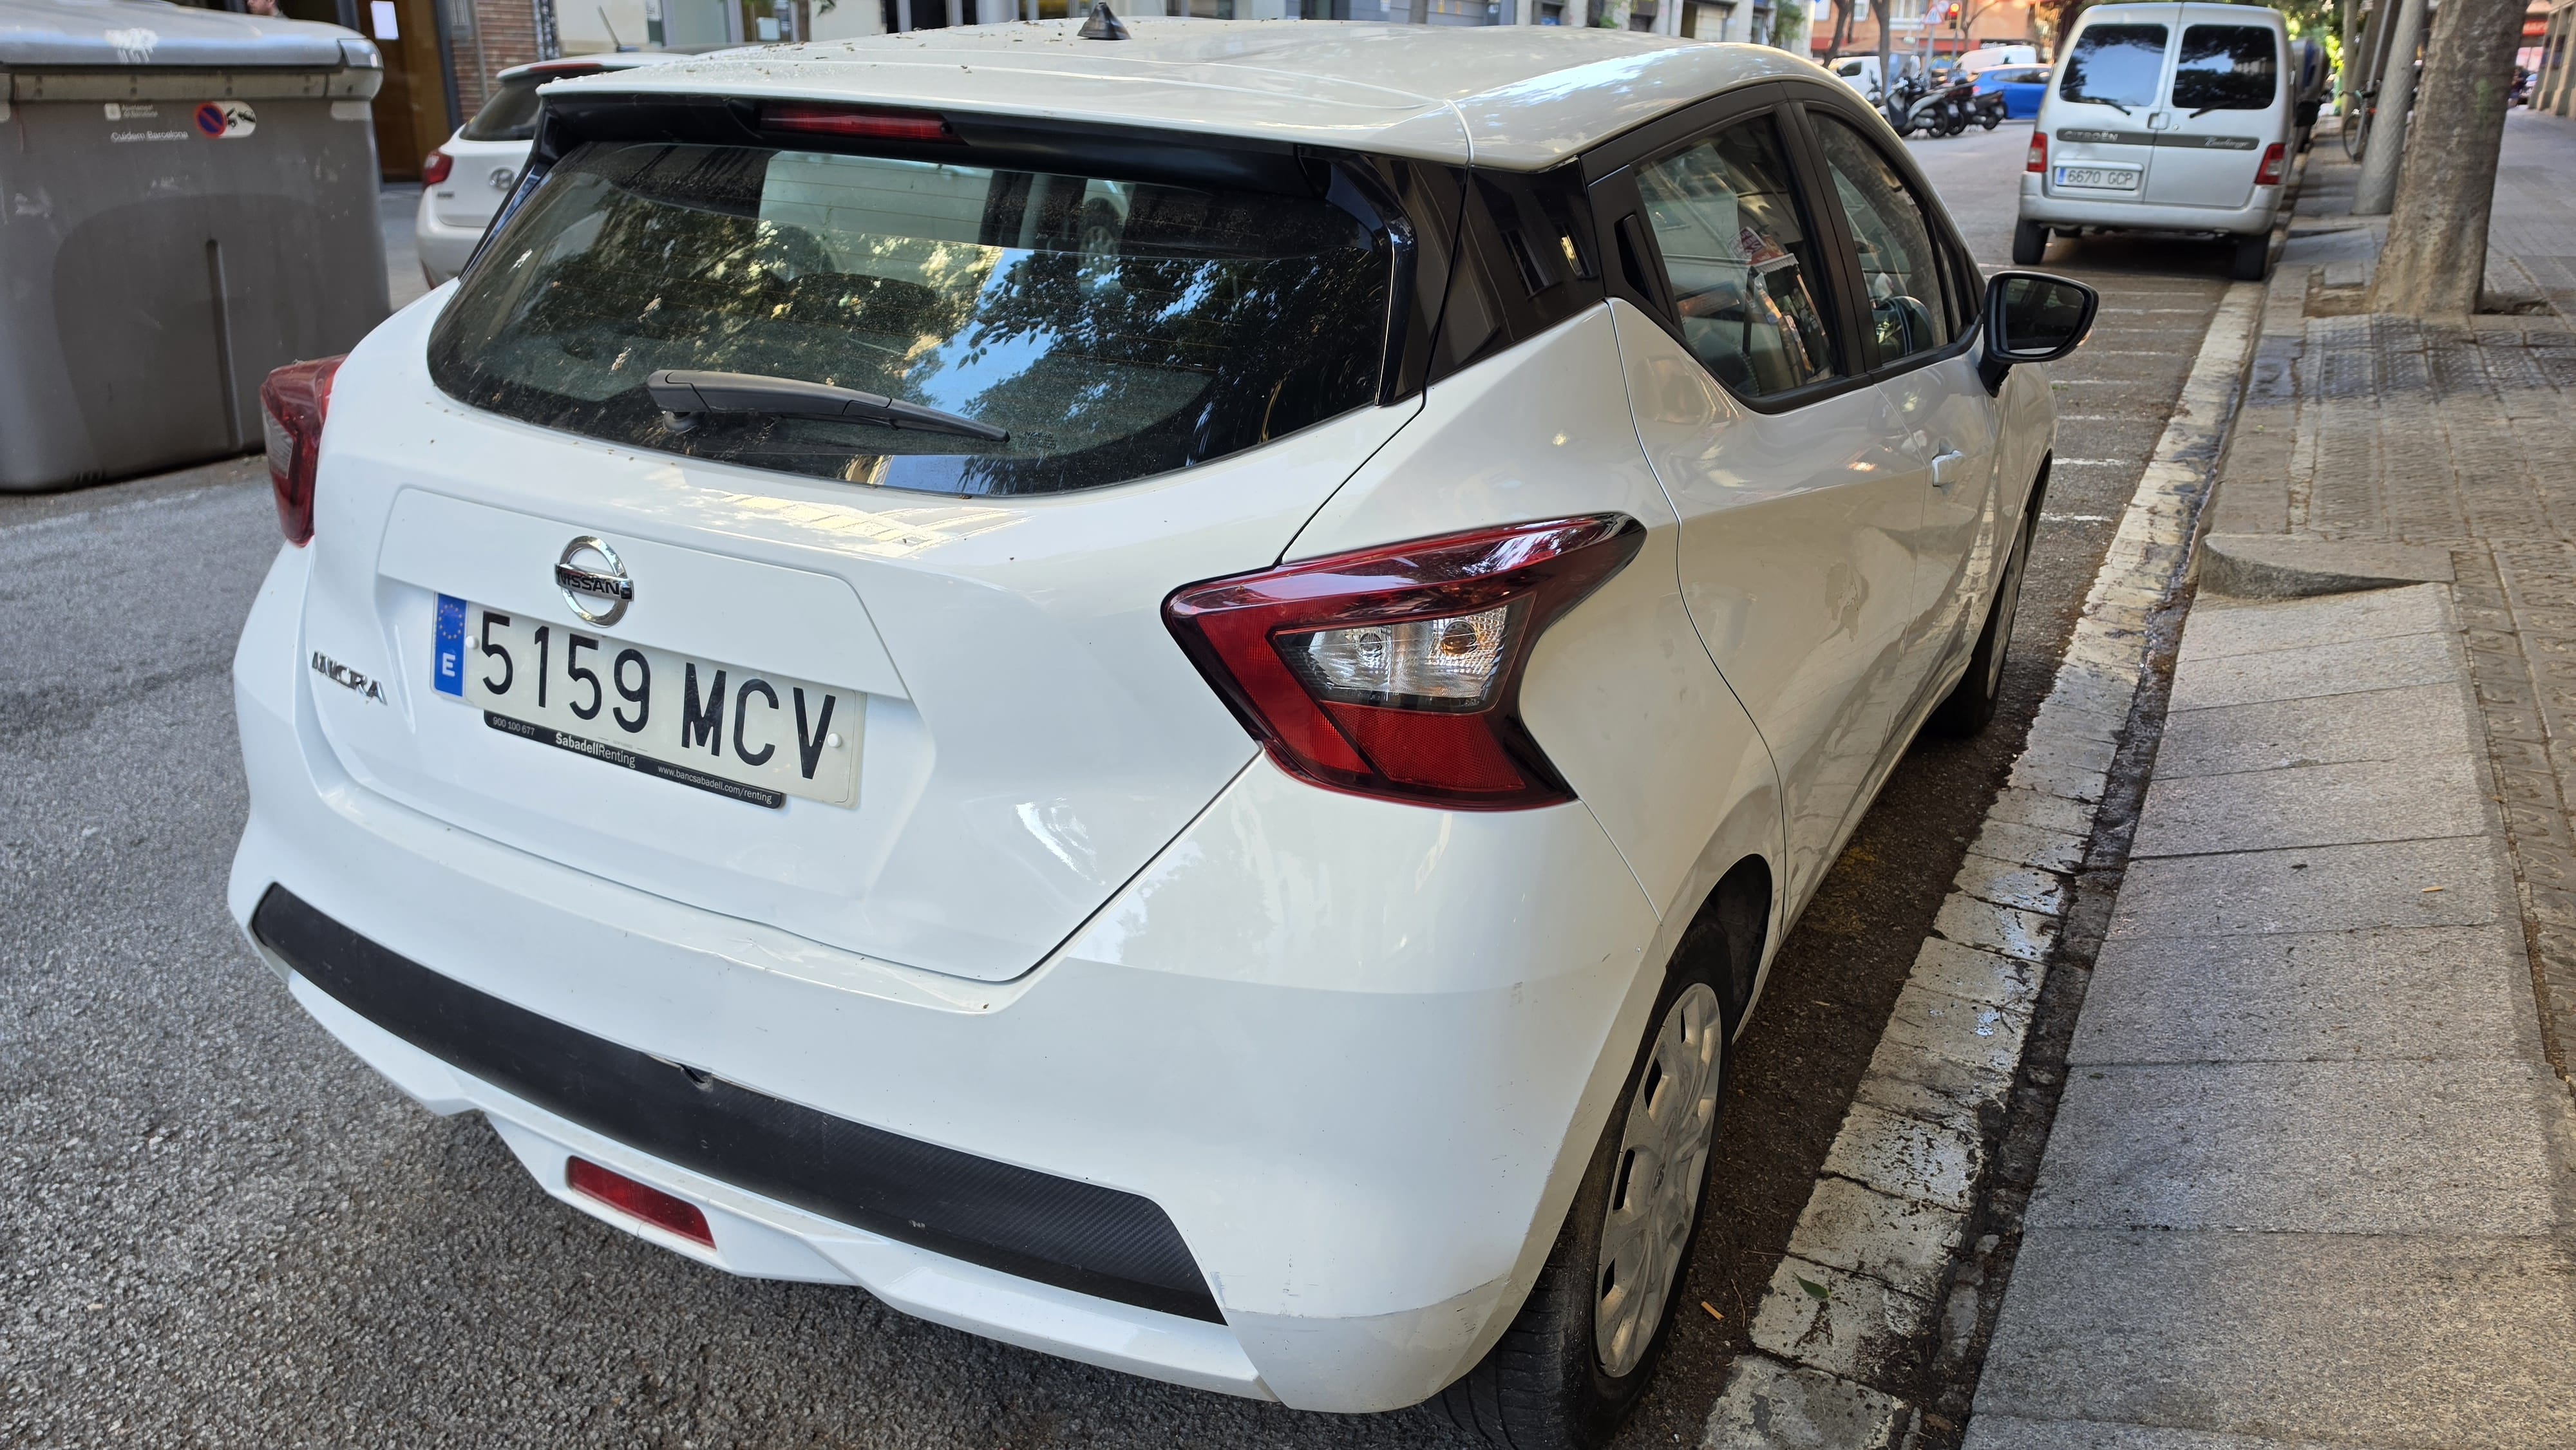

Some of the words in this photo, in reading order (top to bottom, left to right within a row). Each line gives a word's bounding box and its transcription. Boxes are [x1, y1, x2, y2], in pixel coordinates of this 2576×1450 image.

[147, 130, 189, 140] Barcelona
[2064, 131, 2118, 140] CITROËN
[2067, 169, 2101, 184] 6670
[2107, 171, 2134, 185] GCP
[558, 570, 620, 595] NISSAN
[442, 652, 456, 677] E
[312, 650, 388, 706] MICRA
[481, 610, 650, 733] 5159
[681, 662, 837, 780] MCV
[492, 716, 507, 728] 900
[507, 720, 520, 732] 100
[522, 724, 535, 736] 677
[658, 765, 772, 805] www.bancsabadell.com/renting
